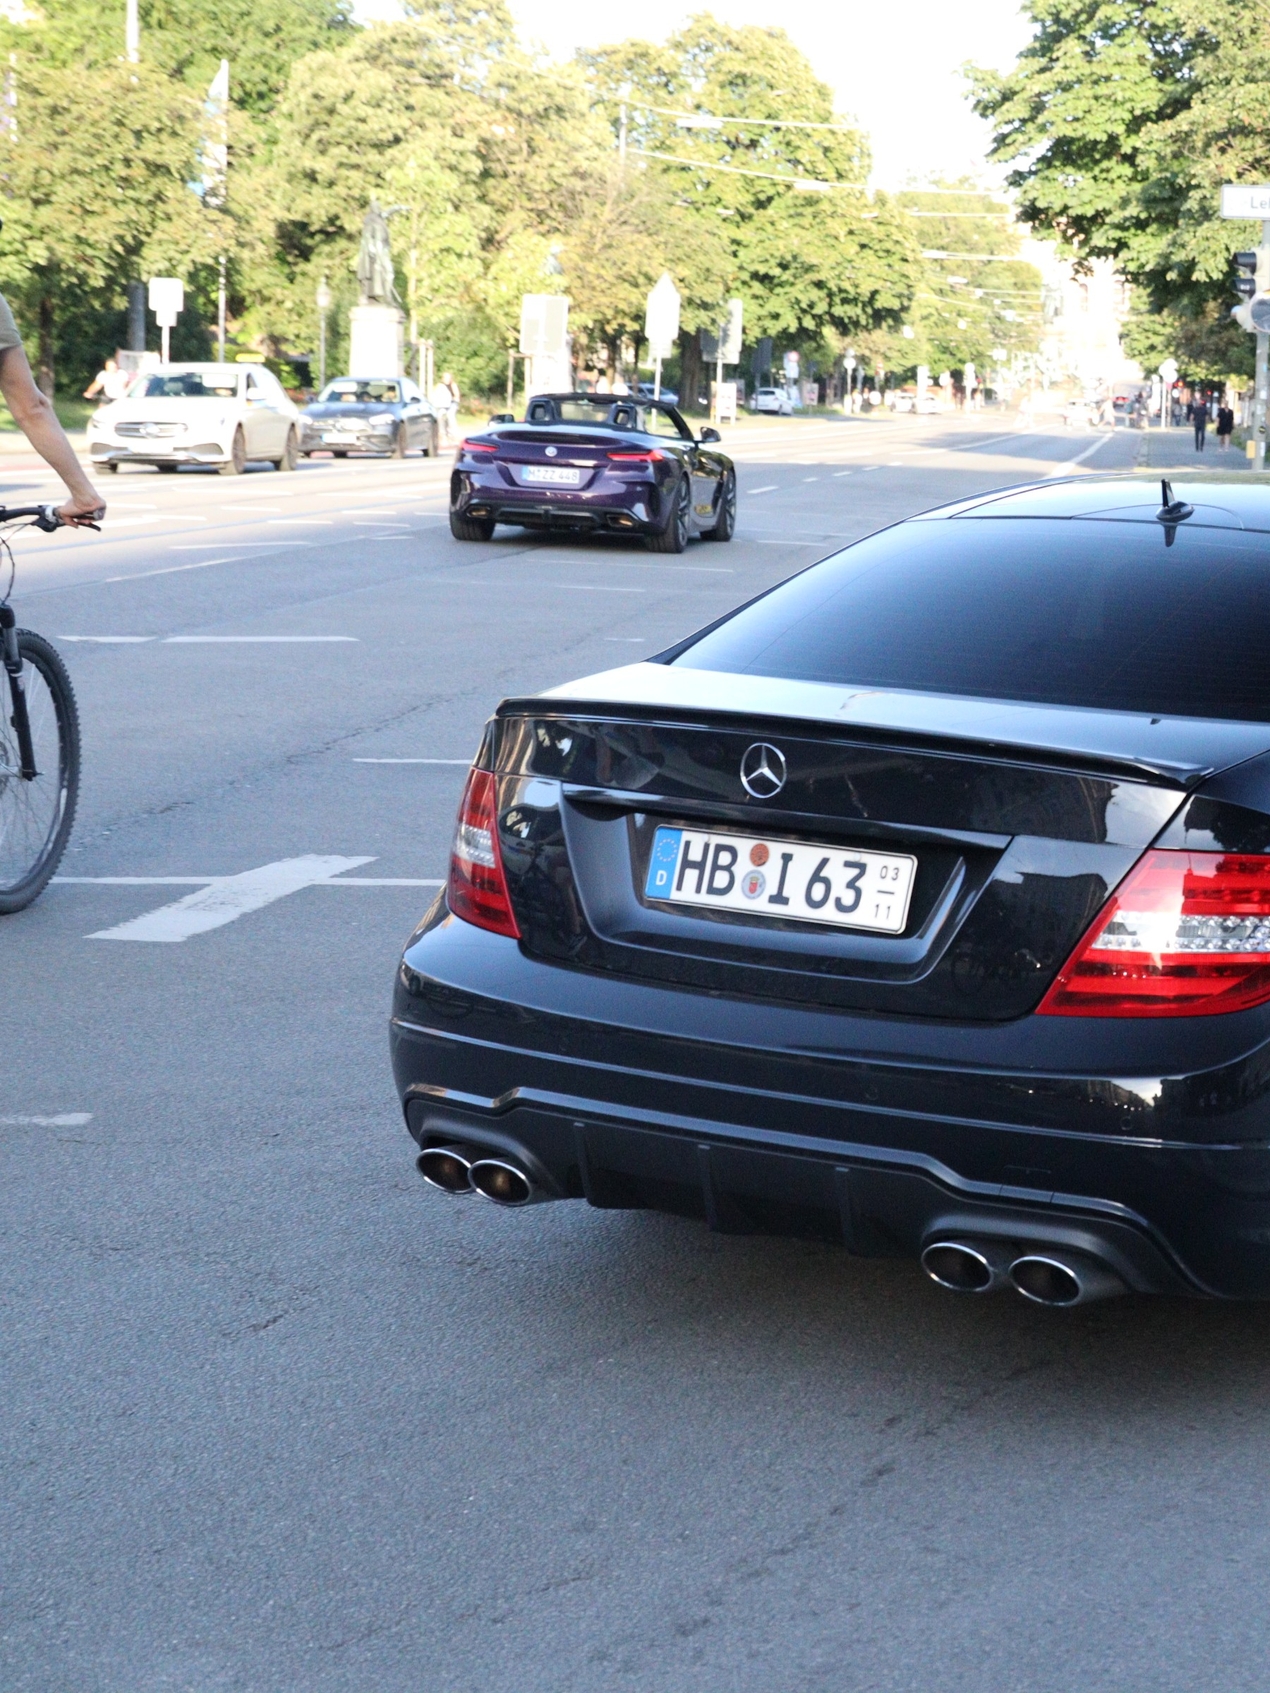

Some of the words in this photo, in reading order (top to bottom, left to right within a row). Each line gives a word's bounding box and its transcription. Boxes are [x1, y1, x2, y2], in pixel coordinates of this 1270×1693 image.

[542, 469, 556, 480] ZZ
[655, 870, 667, 886] D
[676, 840, 738, 896] HB
[768, 852, 794, 906] I
[805, 857, 867, 913] 63
[879, 865, 900, 881] 03
[873, 903, 892, 920] 11
